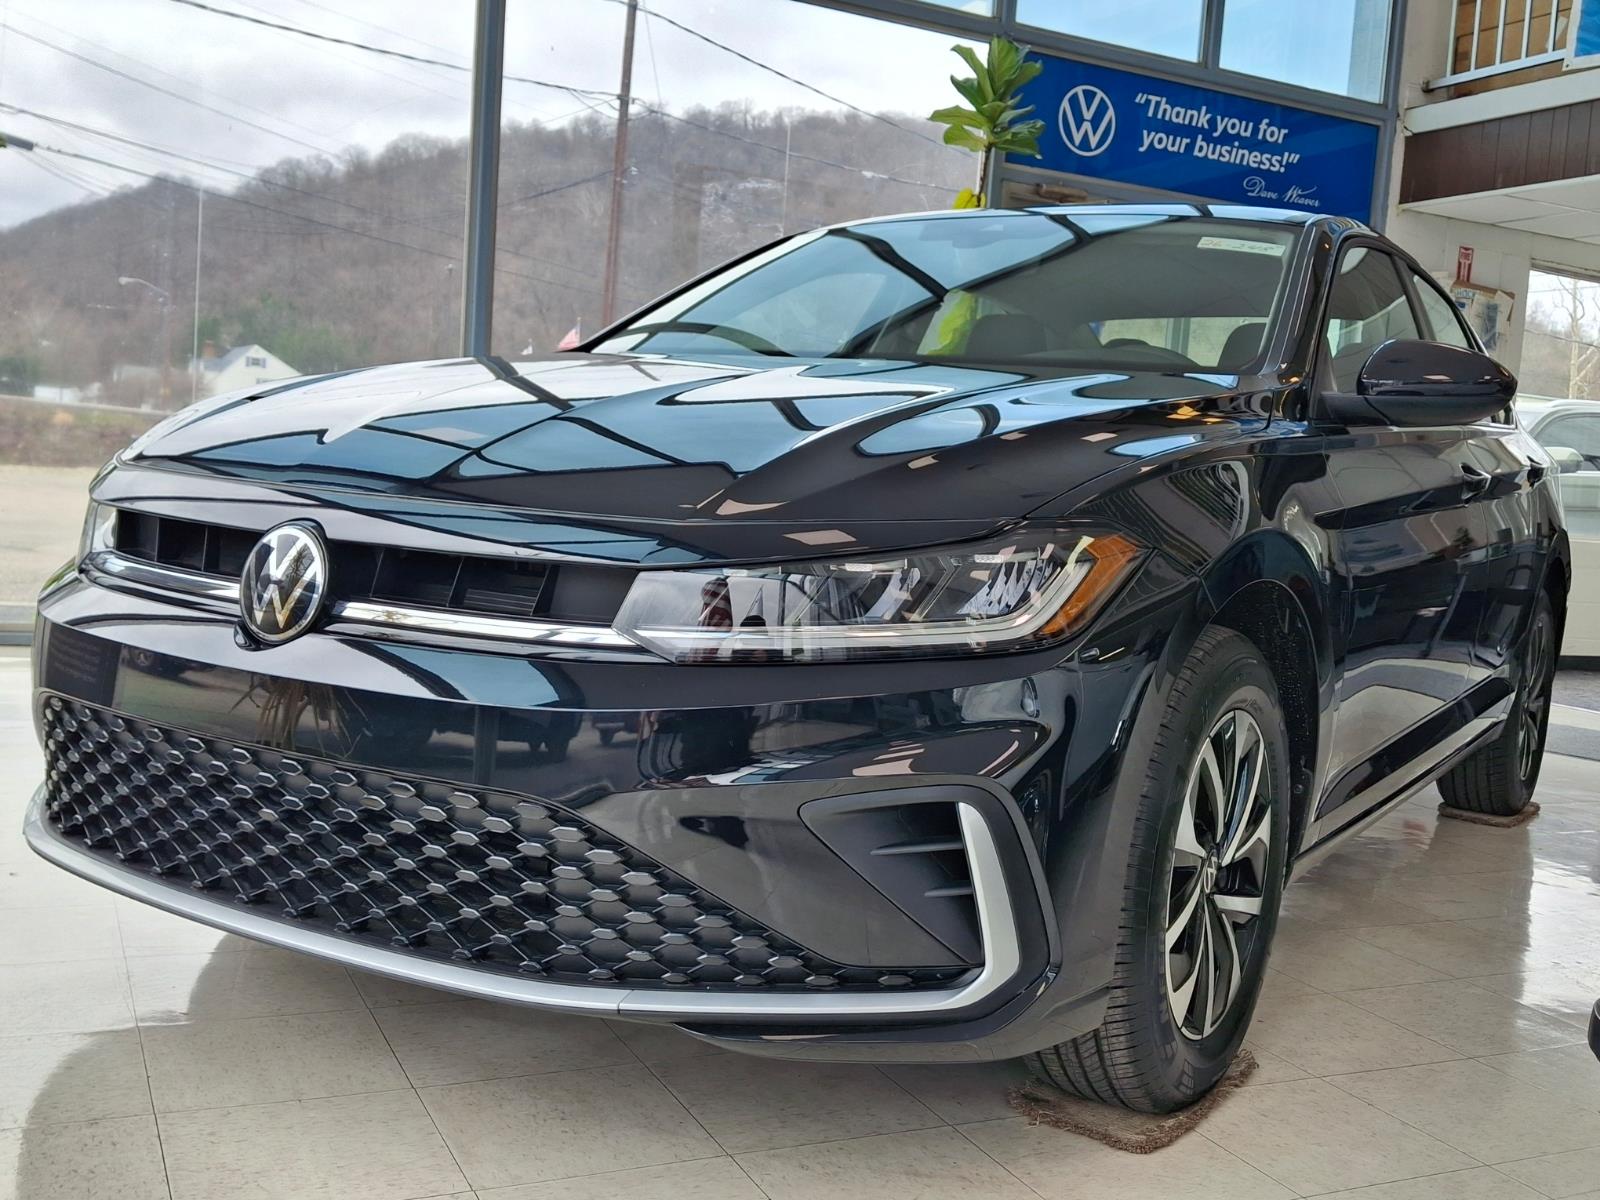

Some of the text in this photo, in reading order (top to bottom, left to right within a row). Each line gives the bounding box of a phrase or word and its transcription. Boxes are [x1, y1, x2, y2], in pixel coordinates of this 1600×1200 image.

[1135, 92, 1288, 145] “Thank you for
[1138, 128, 1300, 173] your business!”
[1243, 176, 1279, 200] Dave
